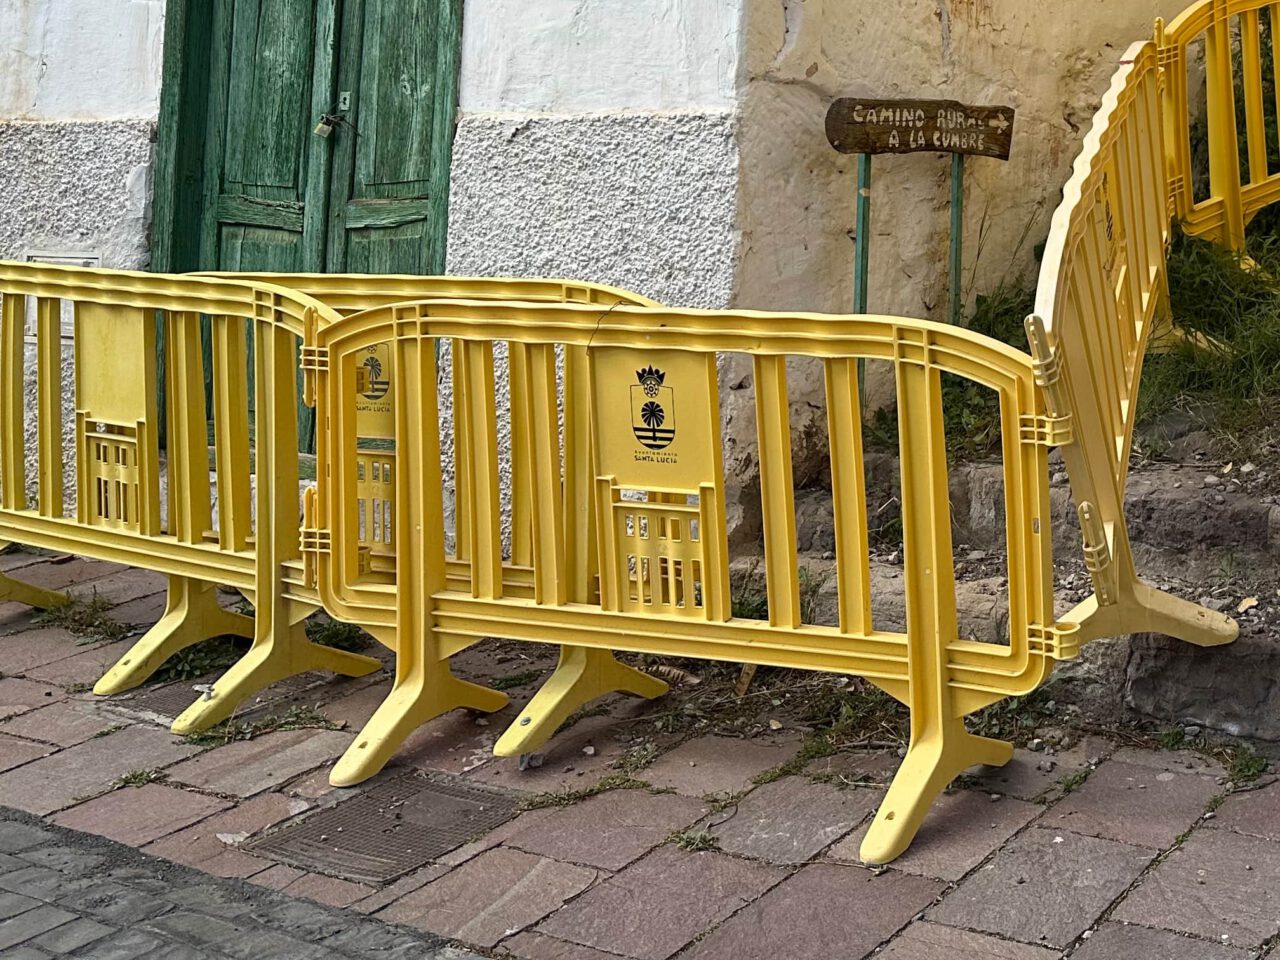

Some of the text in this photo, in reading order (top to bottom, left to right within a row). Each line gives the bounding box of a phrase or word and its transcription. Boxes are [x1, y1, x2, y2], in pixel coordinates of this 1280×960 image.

[853, 105, 925, 127] CAMINO
[888, 129, 985, 151] A LA CUMBRE
